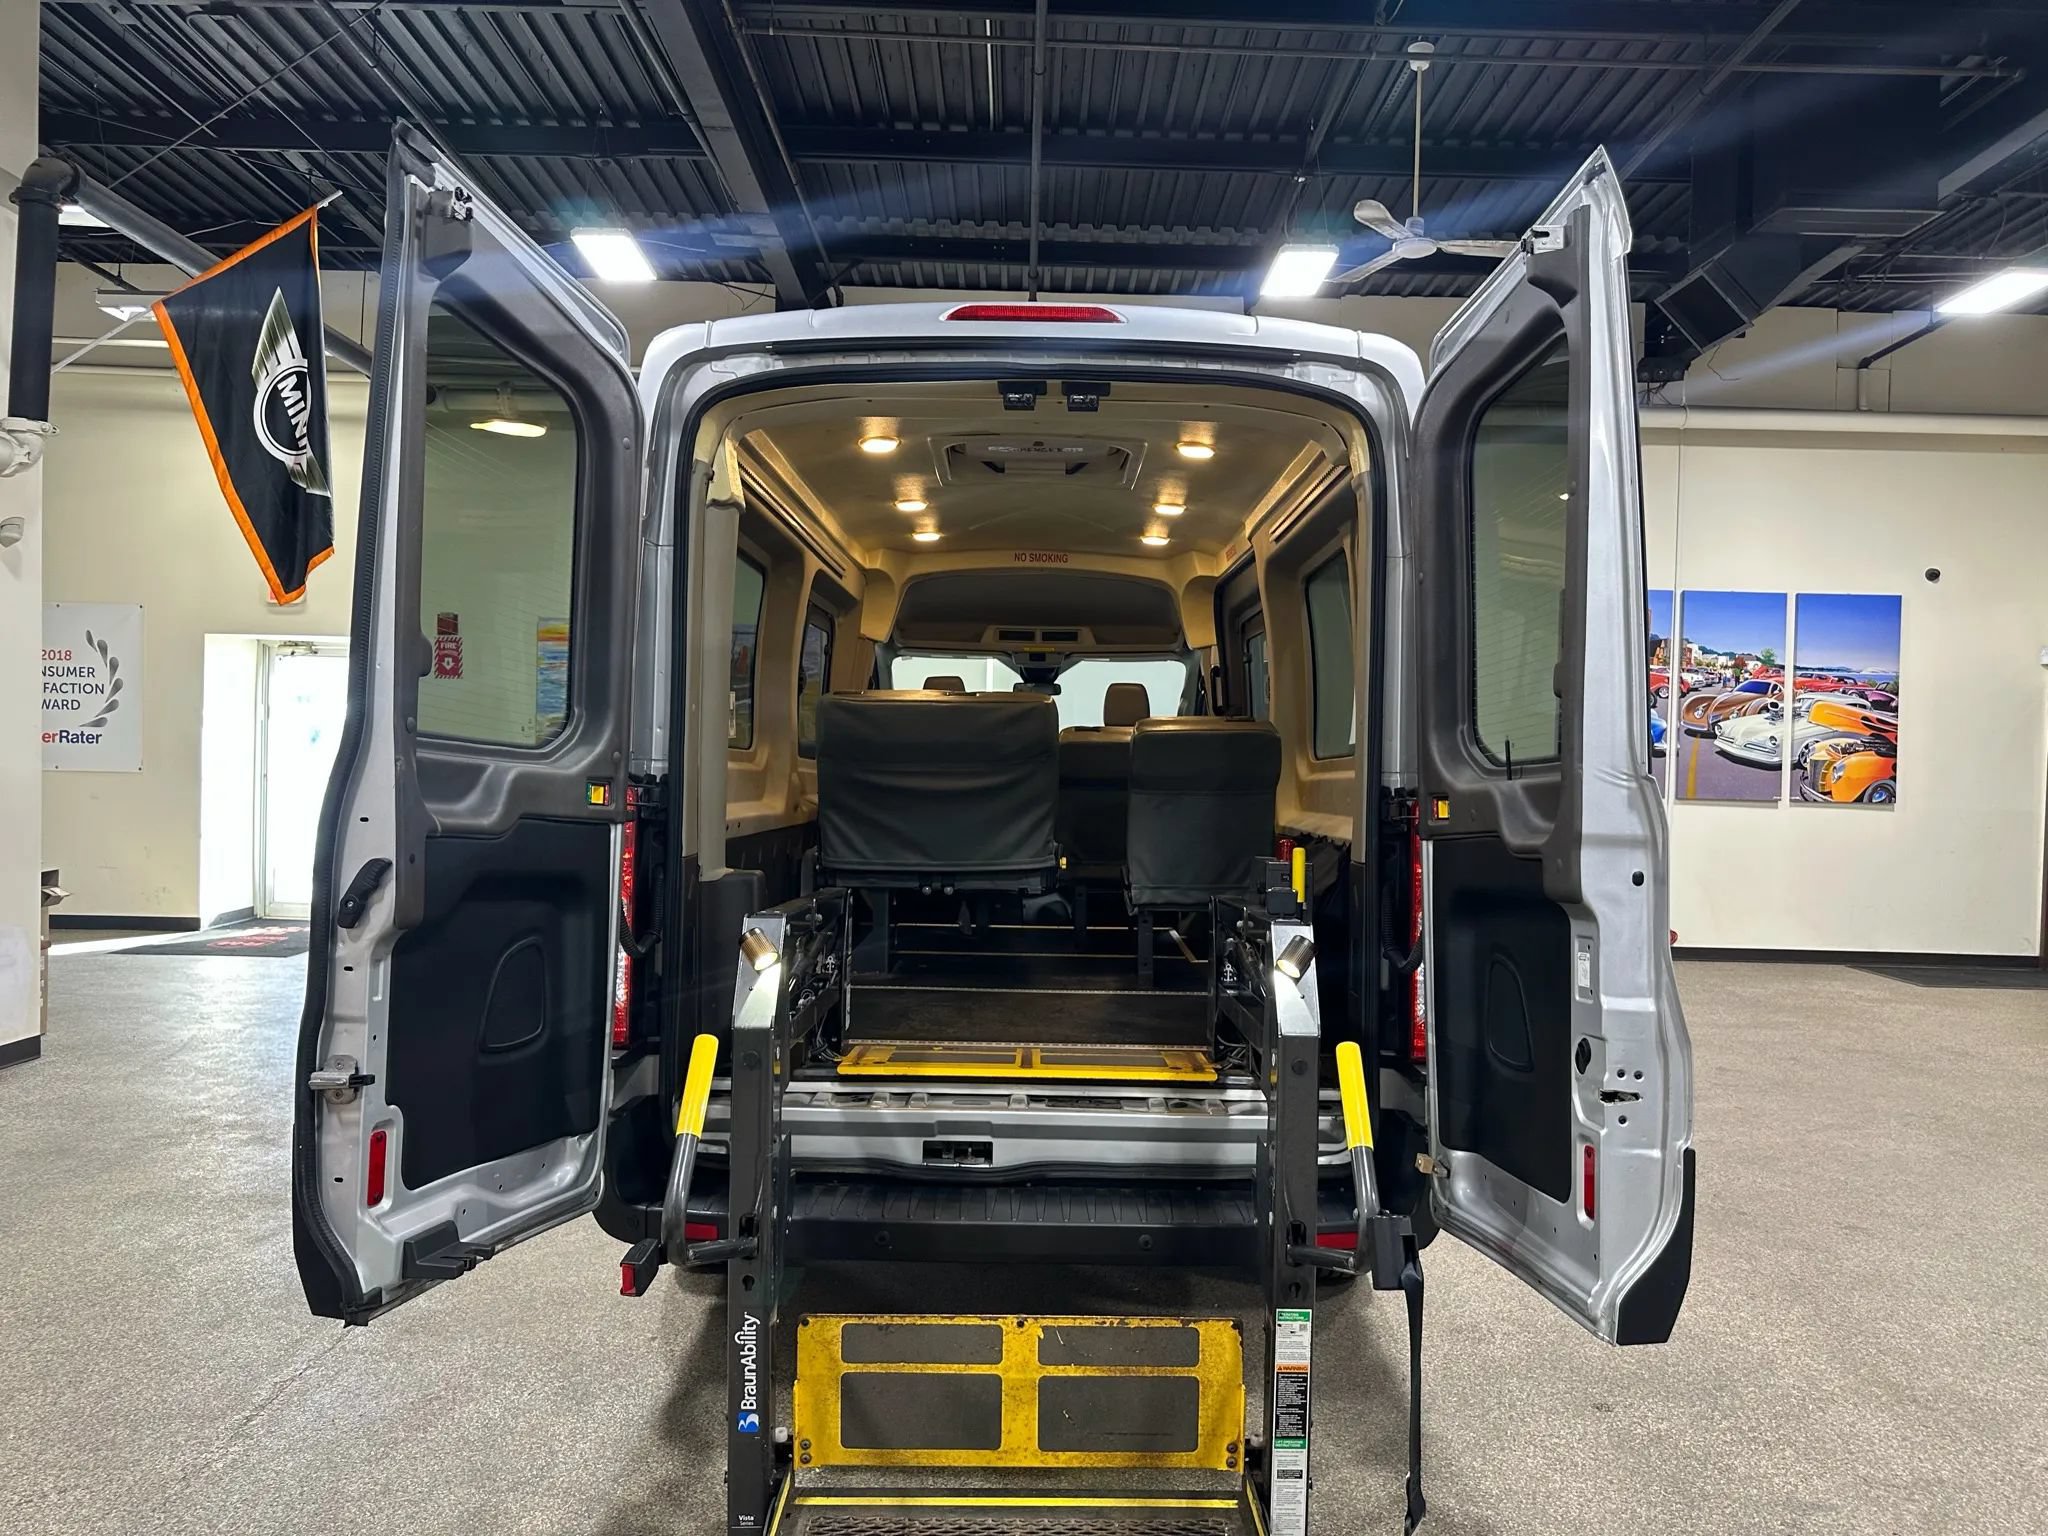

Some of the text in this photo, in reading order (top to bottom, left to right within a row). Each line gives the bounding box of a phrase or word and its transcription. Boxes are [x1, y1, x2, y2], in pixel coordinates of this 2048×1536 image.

[1014, 552, 1069, 563] NO SMOKING
[42, 649, 72, 661] 2018
[43, 682, 105, 694] FACTION
[735, 1312, 760, 1410] BraunAbility
